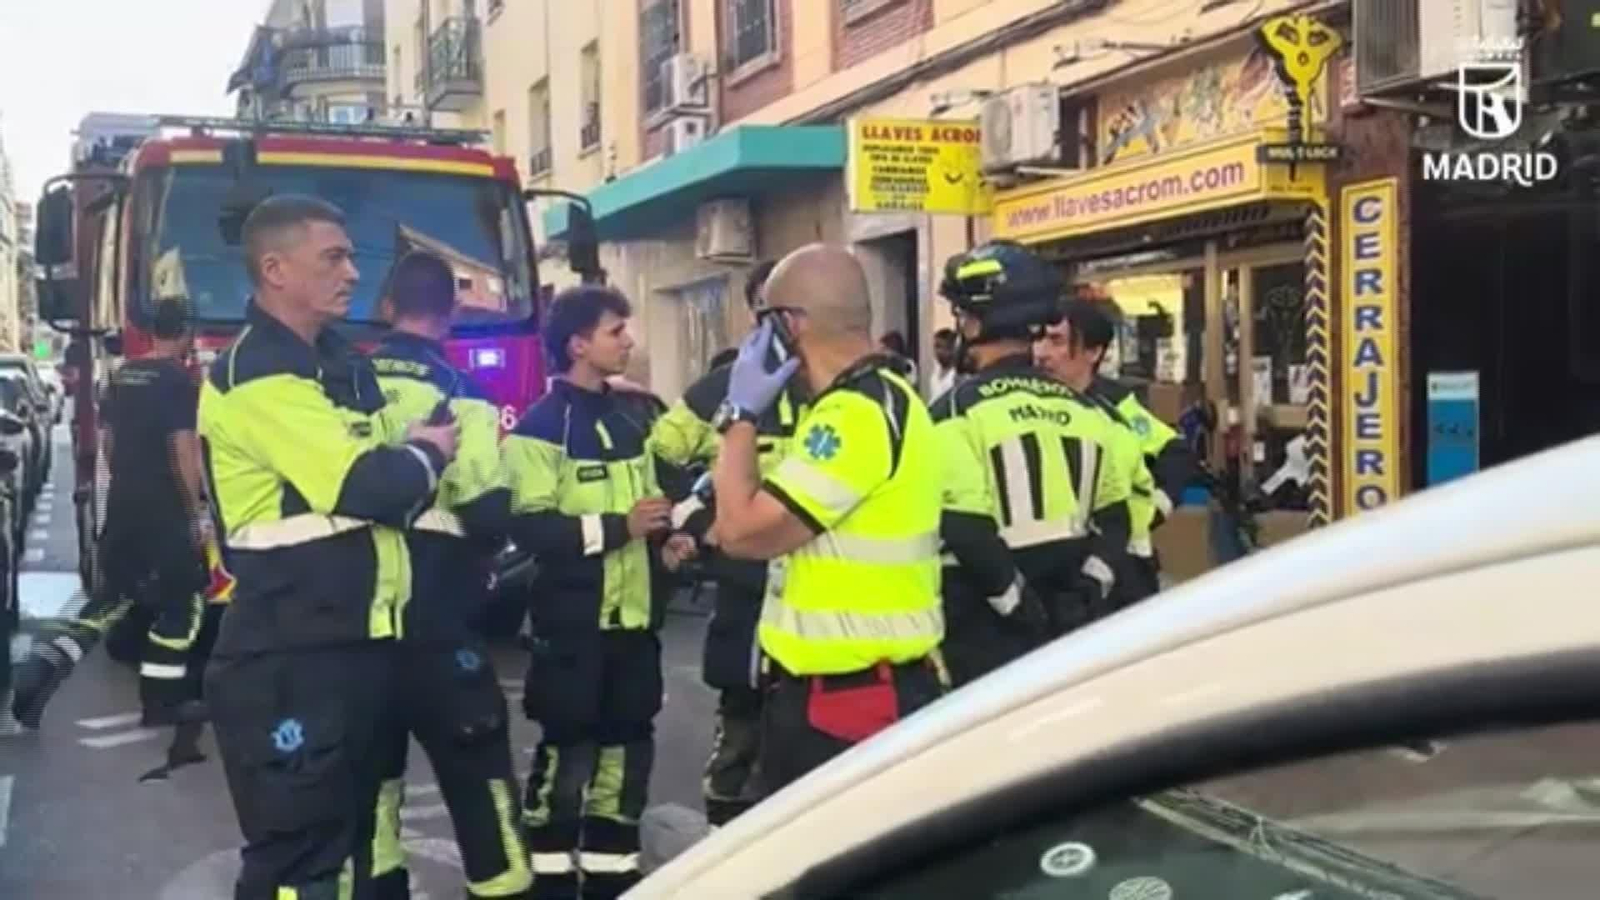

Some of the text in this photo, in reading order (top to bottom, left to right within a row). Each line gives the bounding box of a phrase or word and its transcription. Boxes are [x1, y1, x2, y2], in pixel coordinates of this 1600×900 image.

[862, 126, 922, 140] LLAVES
[1006, 160, 1245, 228] www.llavesacrom.com
[1353, 196, 1387, 511] CERRAJERO
